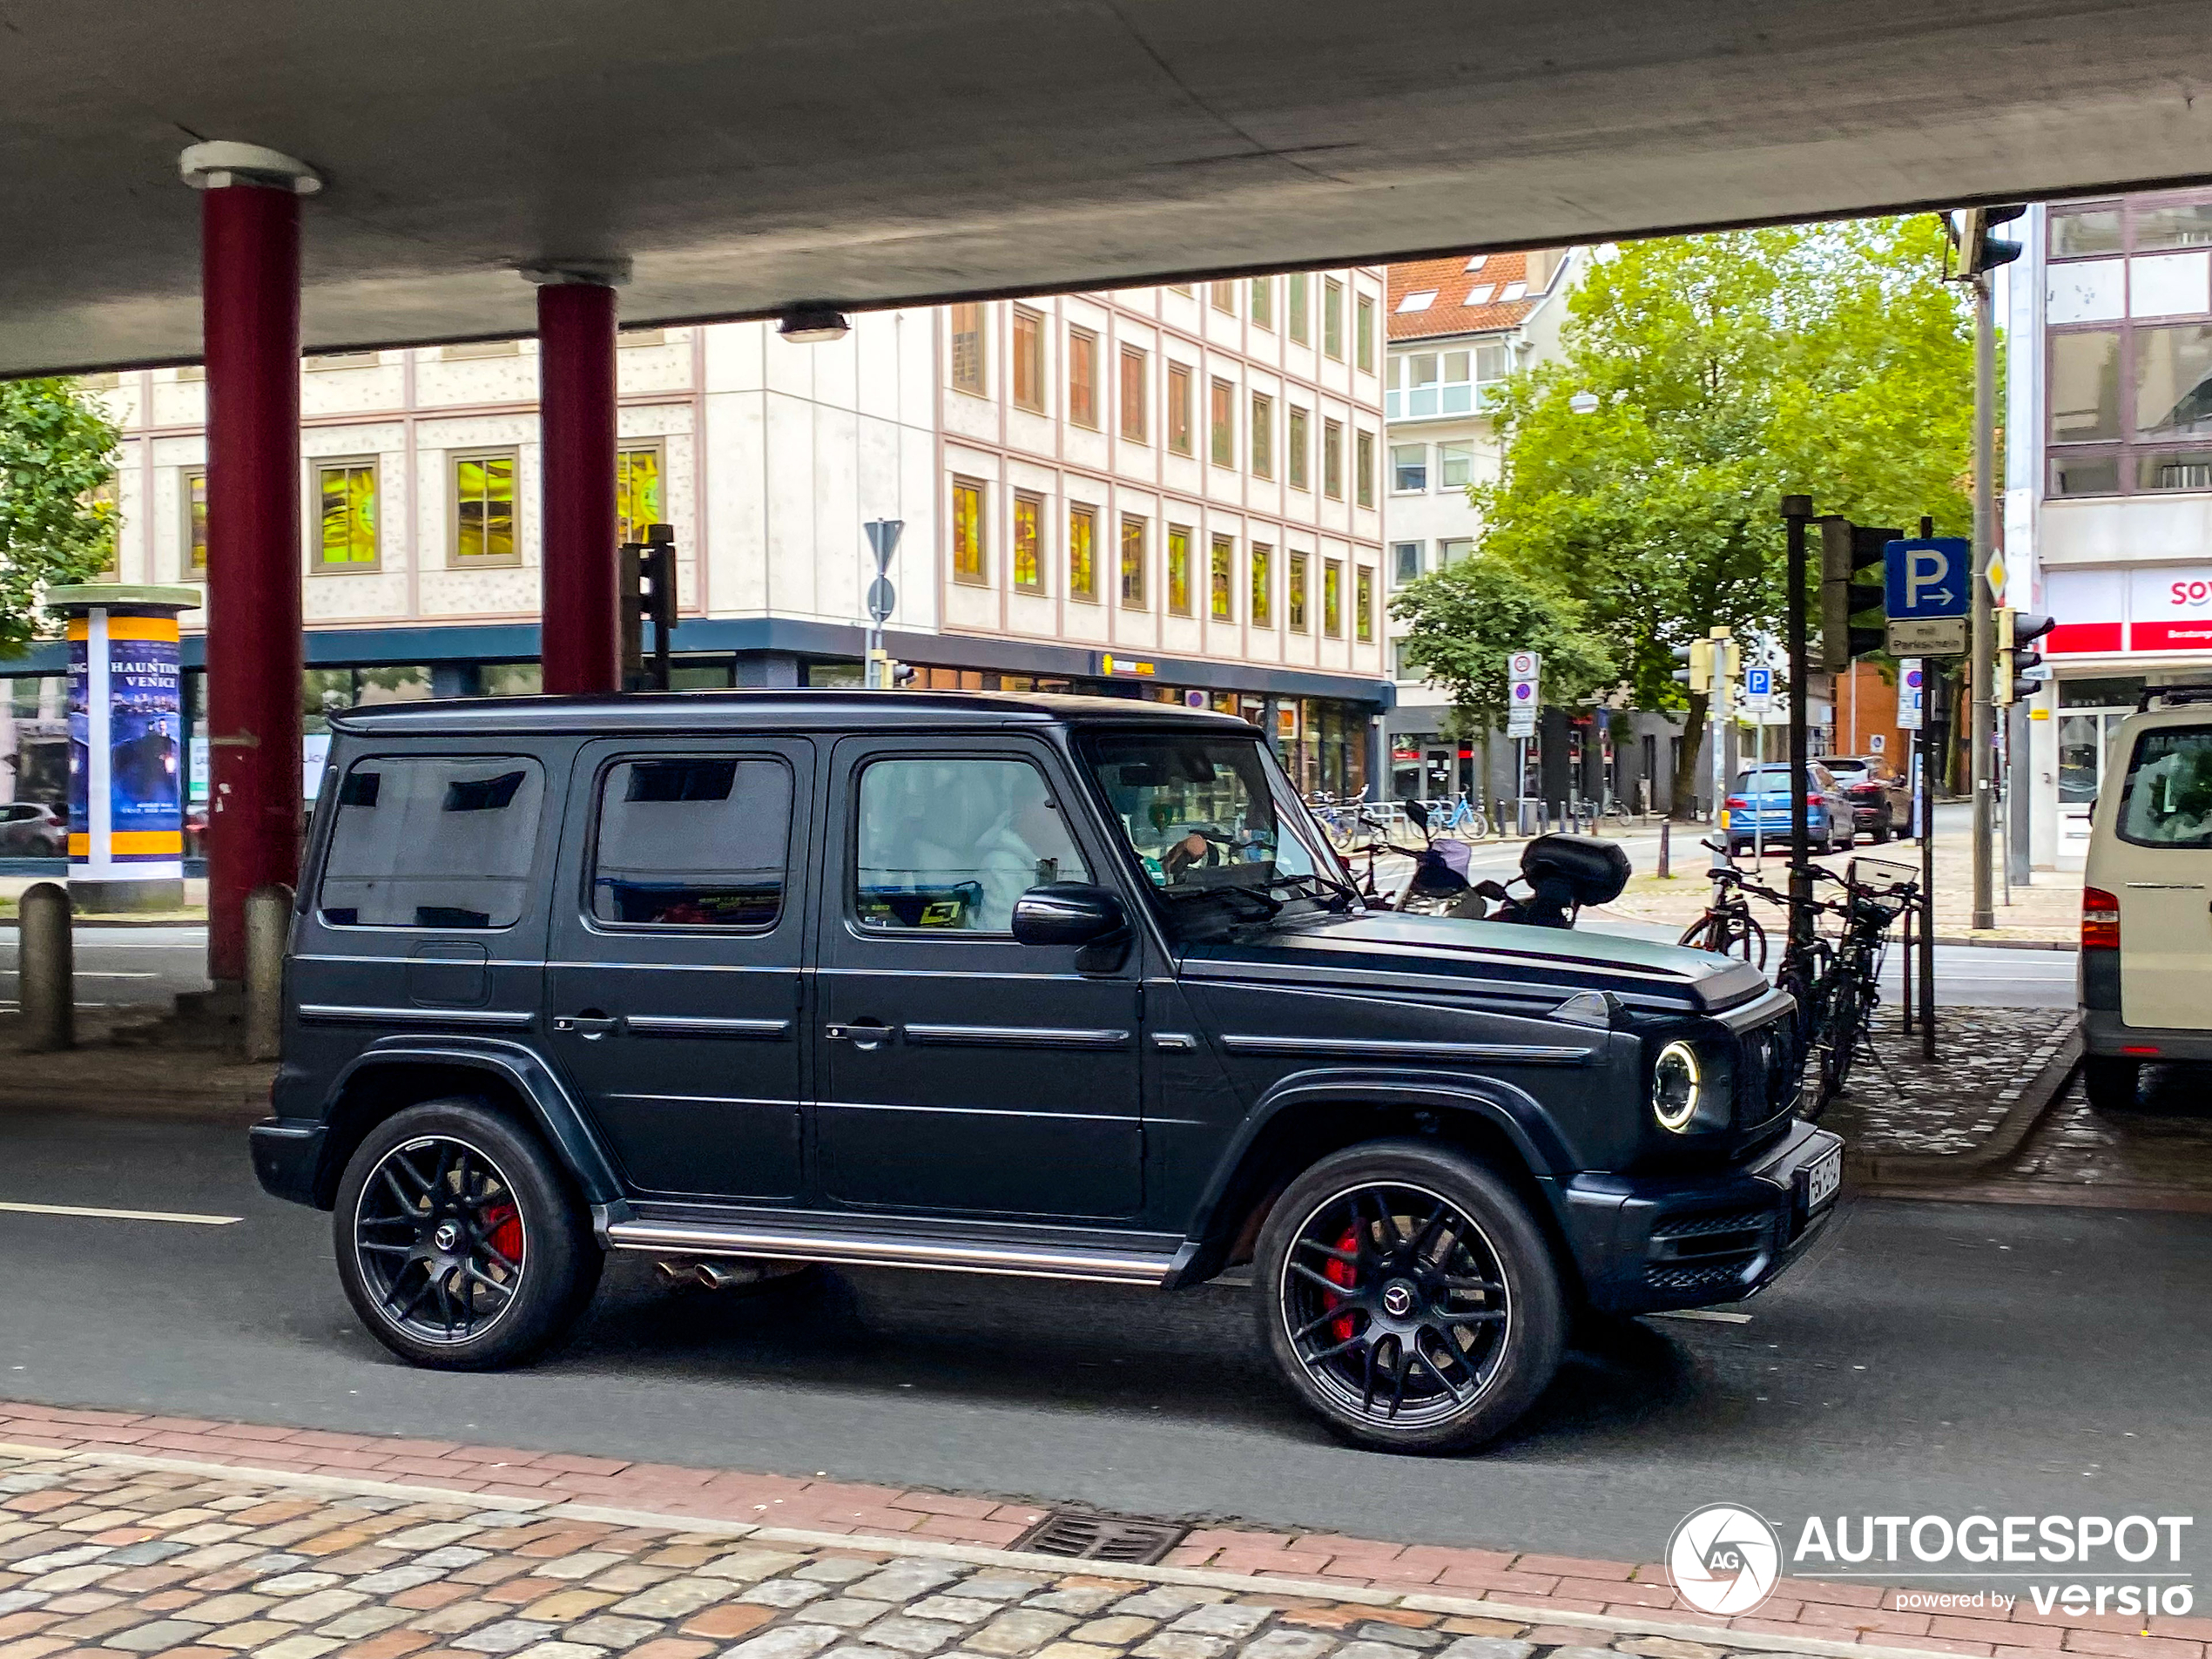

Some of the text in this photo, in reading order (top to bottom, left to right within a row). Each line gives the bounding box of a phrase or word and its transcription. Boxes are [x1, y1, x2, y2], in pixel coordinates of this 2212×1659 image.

[1905, 550, 1949, 608] P
[2171, 581, 2212, 605] So
[111, 662, 179, 674] HAUNTIN
[1752, 672, 1765, 691] P
